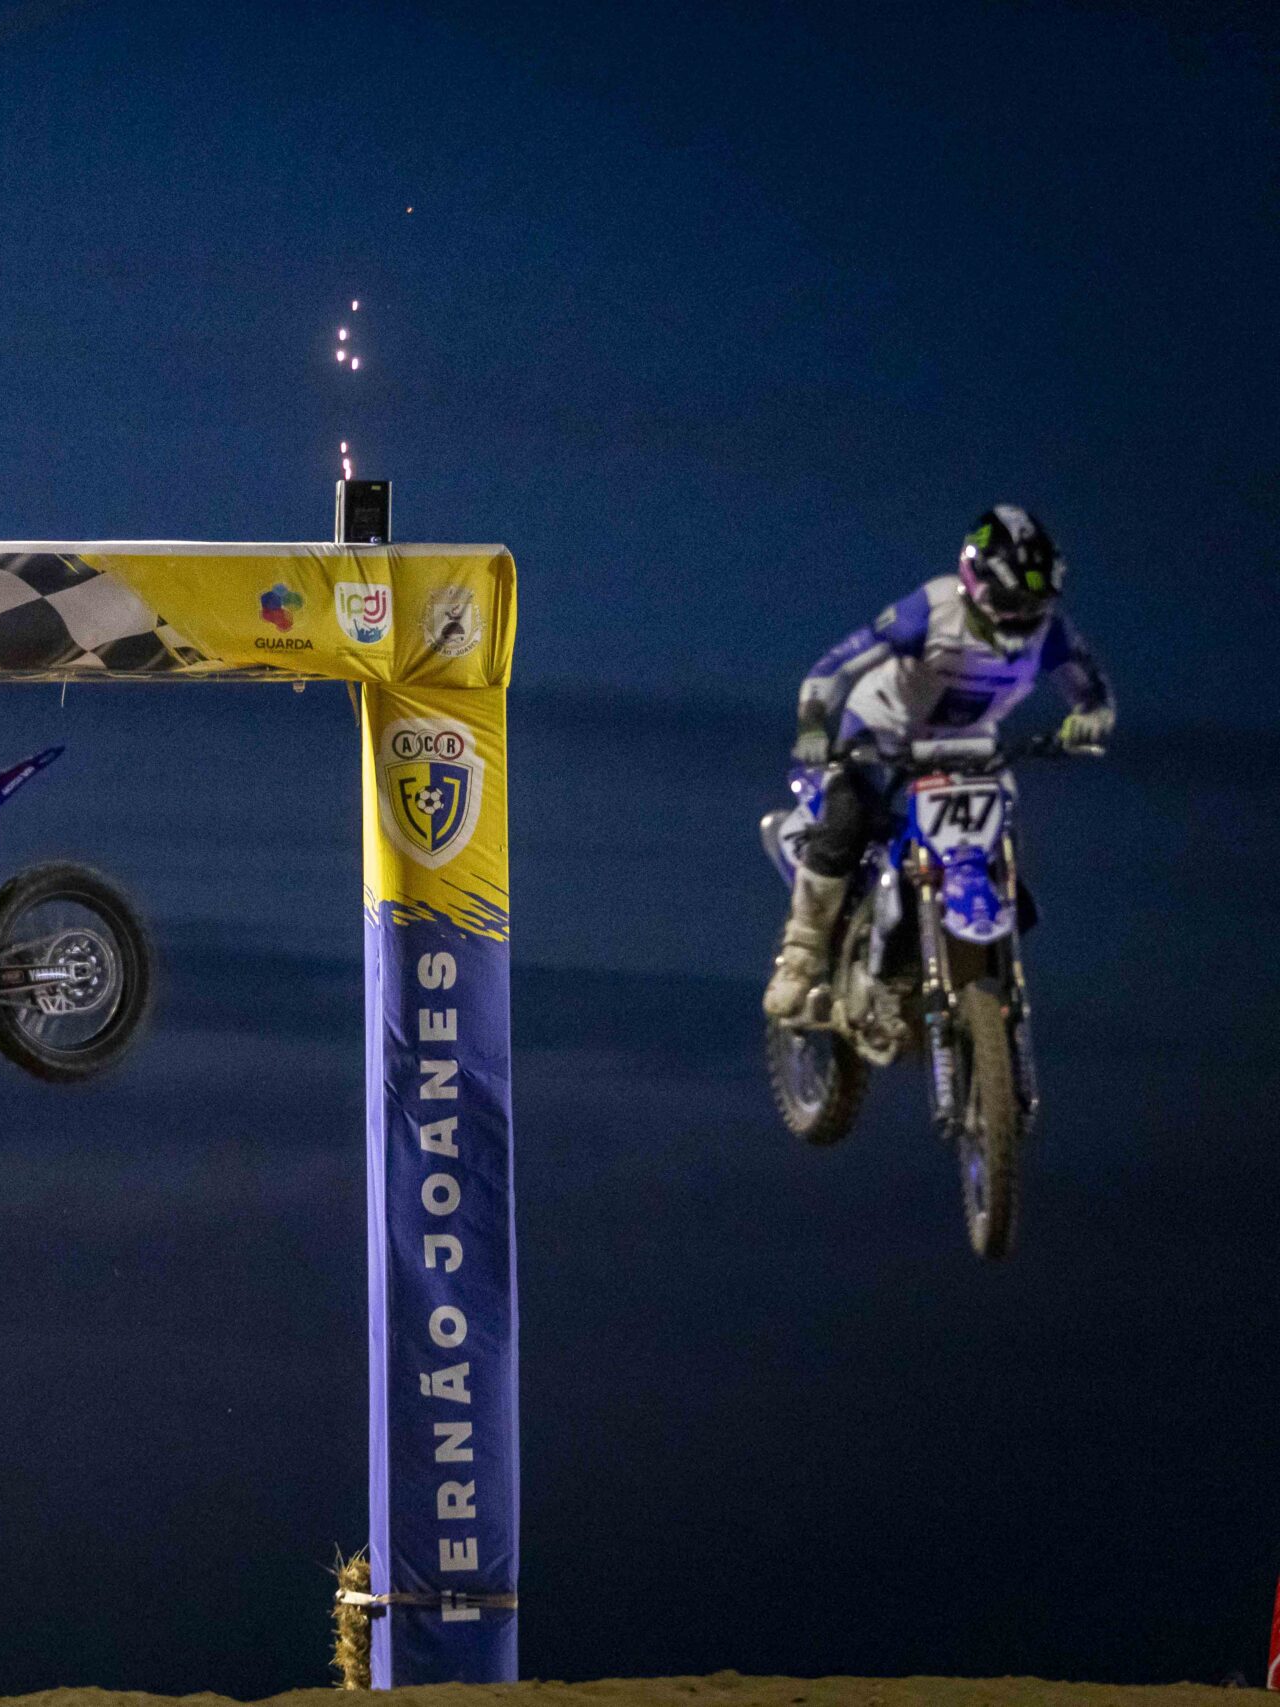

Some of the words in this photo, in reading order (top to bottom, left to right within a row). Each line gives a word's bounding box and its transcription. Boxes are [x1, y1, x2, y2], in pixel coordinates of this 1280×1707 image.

[254, 637, 314, 651] GUARDA
[928, 793, 996, 837] 747
[417, 951, 464, 1274] JOANES
[420, 1305, 481, 1622] FERNÃO
